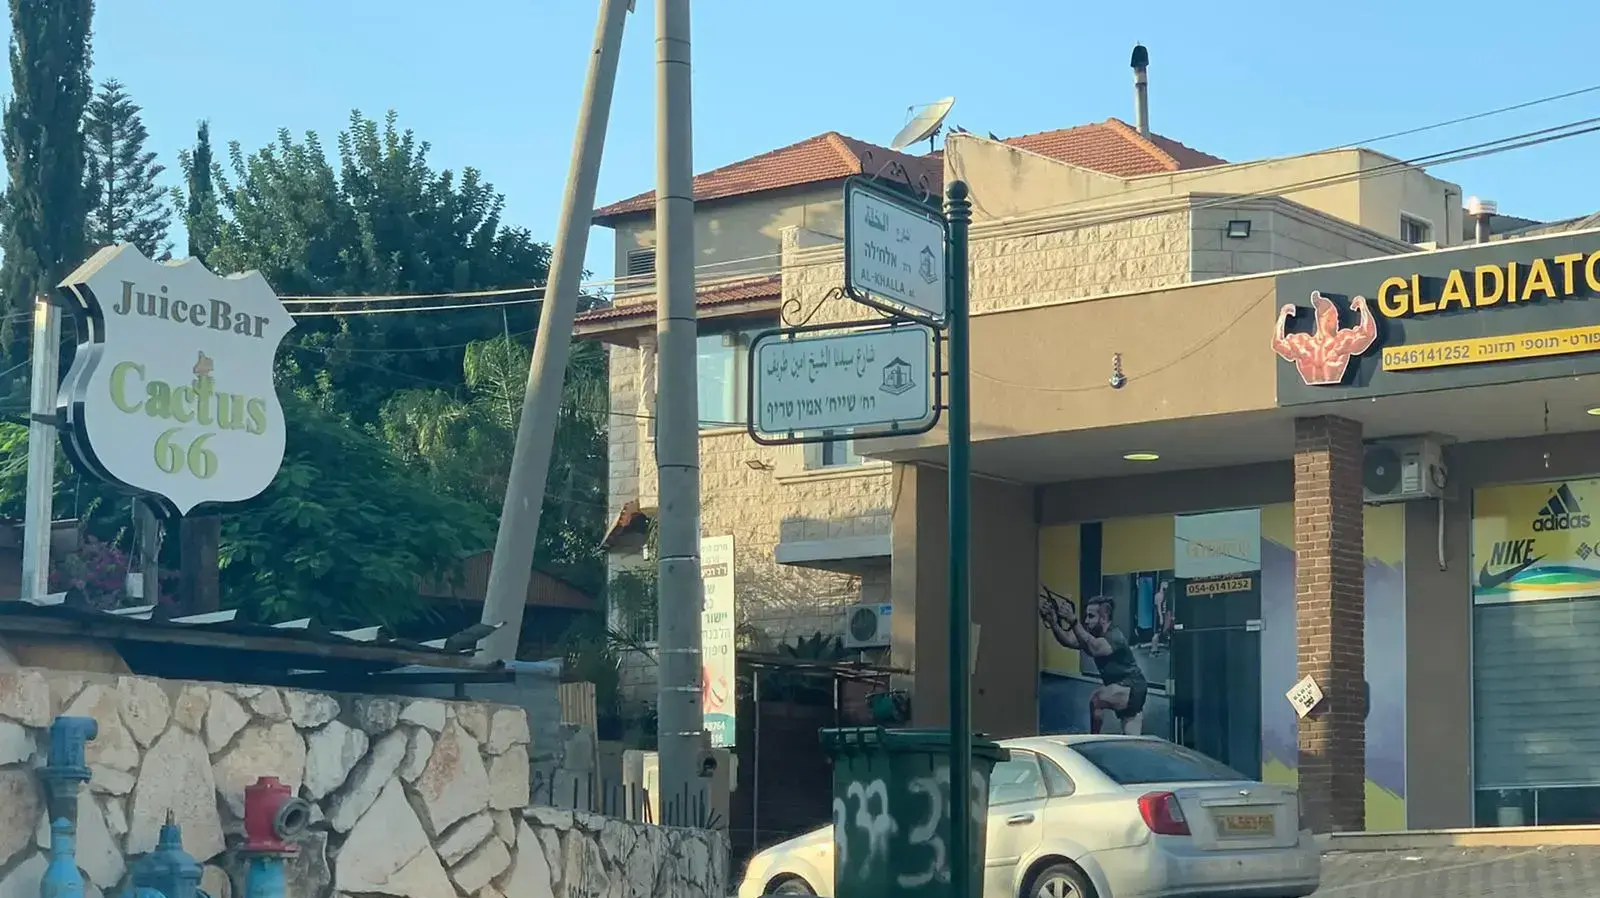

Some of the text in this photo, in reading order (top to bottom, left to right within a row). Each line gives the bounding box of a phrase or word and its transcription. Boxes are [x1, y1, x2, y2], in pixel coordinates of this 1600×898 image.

[861, 268, 905, 295] AL-KHALLA
[1384, 345, 1470, 366] 0546141252
[1478, 341, 1515, 355] תזונה
[1521, 337, 1559, 350] תוספי
[808, 344, 831, 383] الشيخ
[856, 344, 875, 377] شارع
[109, 359, 266, 435] Cactus
[797, 397, 822, 421] אמין
[767, 400, 794, 424] טריף
[154, 427, 218, 479] 66
[1532, 512, 1591, 532] adidas
[1490, 539, 1536, 565] NIKE
[1189, 580, 1248, 593] 054-6141252
